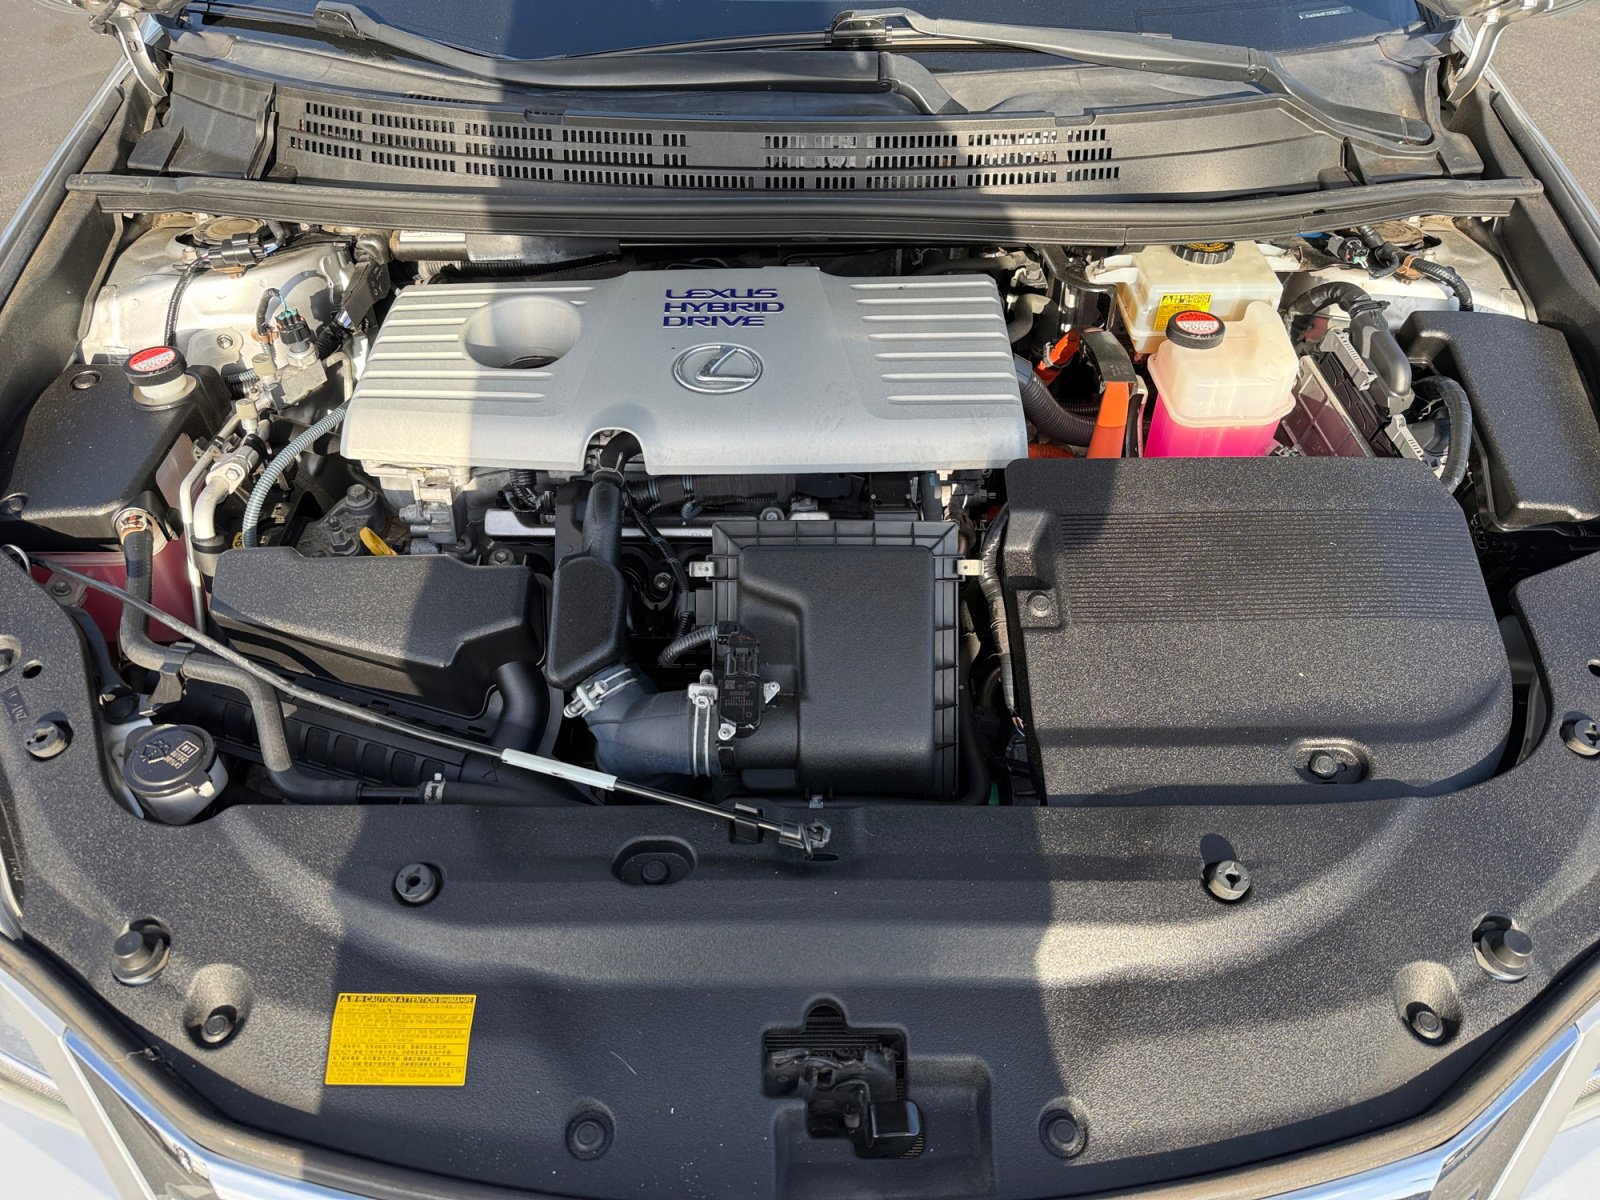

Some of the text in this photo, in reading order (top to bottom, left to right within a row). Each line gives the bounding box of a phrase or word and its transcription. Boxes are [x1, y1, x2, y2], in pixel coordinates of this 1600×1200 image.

[665, 288, 778, 299] LEXUS
[664, 302, 784, 313] HYBRID
[663, 316, 765, 328] DRIVE
